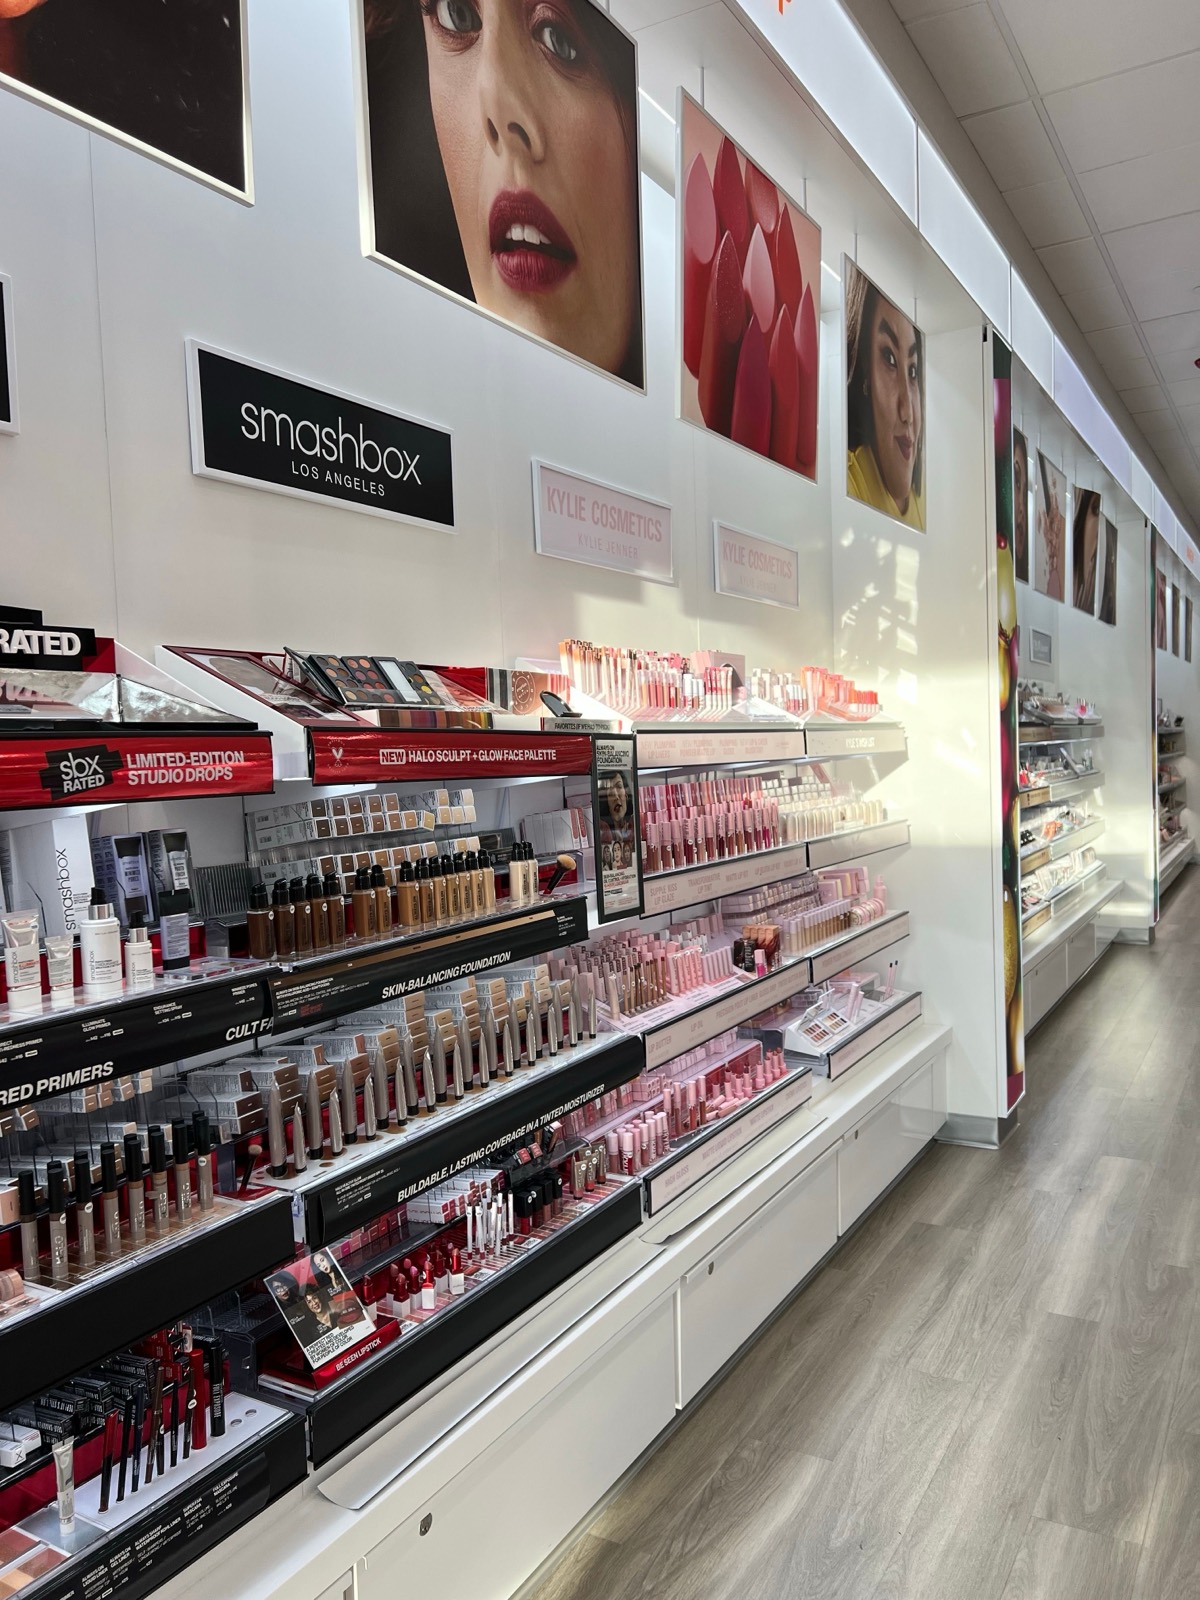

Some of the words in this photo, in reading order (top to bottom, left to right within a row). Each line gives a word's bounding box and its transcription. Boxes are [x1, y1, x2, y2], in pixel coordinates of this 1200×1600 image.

[240, 402, 422, 485] smashbox
[291, 460, 320, 480] LOS
[325, 469, 386, 497] ANGELES
[547, 486, 586, 522] KYLIE
[591, 500, 662, 543] COSMETICS
[578, 531, 602, 550] KYLIE
[606, 536, 638, 559] JENNER
[722, 540, 745, 566] KYLIE
[748, 549, 792, 580] COSMETICS
[59, 752, 104, 781] sbx
[126, 750, 245, 768] LIMITED-EDITION
[382, 749, 405, 763] NEW
[408, 749, 435, 762] HALO
[435, 749, 471, 762] SCULPT
[478, 749, 502, 761] GLOW
[503, 749, 524, 761] FACE
[524, 749, 557, 761] PALETTE
[63, 774, 105, 794] RATED
[128, 769, 184, 785] STUDIO
[185, 766, 233, 783] DROPS
[56, 848, 76, 930] smashbox
[381, 966, 459, 1000] SKIN-BALANCING
[459, 950, 511, 975] FOUNDATION
[153, 1002, 176, 1011] ENDURANCE
[154, 1007, 171, 1015] SETTING
[81, 1018, 106, 1028] ILLUMINATE
[82, 1024, 95, 1032] GLOW
[95, 1021, 112, 1029] PRIMER
[225, 1020, 260, 1041] CULT
[25, 1038, 43, 1047] PRIMER
[36, 1061, 114, 1096] PRIMERS
[397, 1164, 449, 1203] BUILDABLE,
[448, 1147, 485, 1177] LASTING
[484, 1128, 526, 1156] COVERAGE
[525, 1123, 533, 1137] IN
[533, 1121, 539, 1132] A
[538, 1106, 564, 1129] TINTED
[563, 1083, 605, 1118] MOISTURIZER
[307, 1341, 326, 1356] CREATED
[325, 1338, 334, 1347] AND
[333, 1325, 355, 1341] DEVELOPED
[309, 1337, 326, 1351] PERFECT
[325, 1332, 334, 1340] RED
[312, 1356, 321, 1364] FOR
[320, 1347, 335, 1360] PEOPLE
[340, 1336, 353, 1347] COLOR
[315, 1345, 331, 1357] WOMEN
[334, 1334, 348, 1346] COLOR
[335, 1363, 344, 1372] BE
[343, 1353, 359, 1367] SEEN
[357, 1337, 382, 1358] LIPSTICK
[212, 1482, 222, 1492] FULL
[220, 1472, 239, 1488] EXPOSURE
[213, 1482, 231, 1496] MASCARA
[184, 1502, 202, 1517] MASCARA
[134, 1532, 150, 1547] ALWAYS
[149, 1524, 162, 1537] SHARP
[135, 1529, 161, 1551] WATERPROOF
[160, 1523, 170, 1535] KOHL
[169, 1516, 181, 1529] LINER
[109, 1549, 126, 1564] ALWAYS
[110, 1559, 119, 1568] GEL
[119, 1552, 131, 1563] LINER
[81, 1567, 99, 1583] ALWAYS
[82, 1574, 97, 1588] LIQUID
[96, 1567, 109, 1579] LINER
